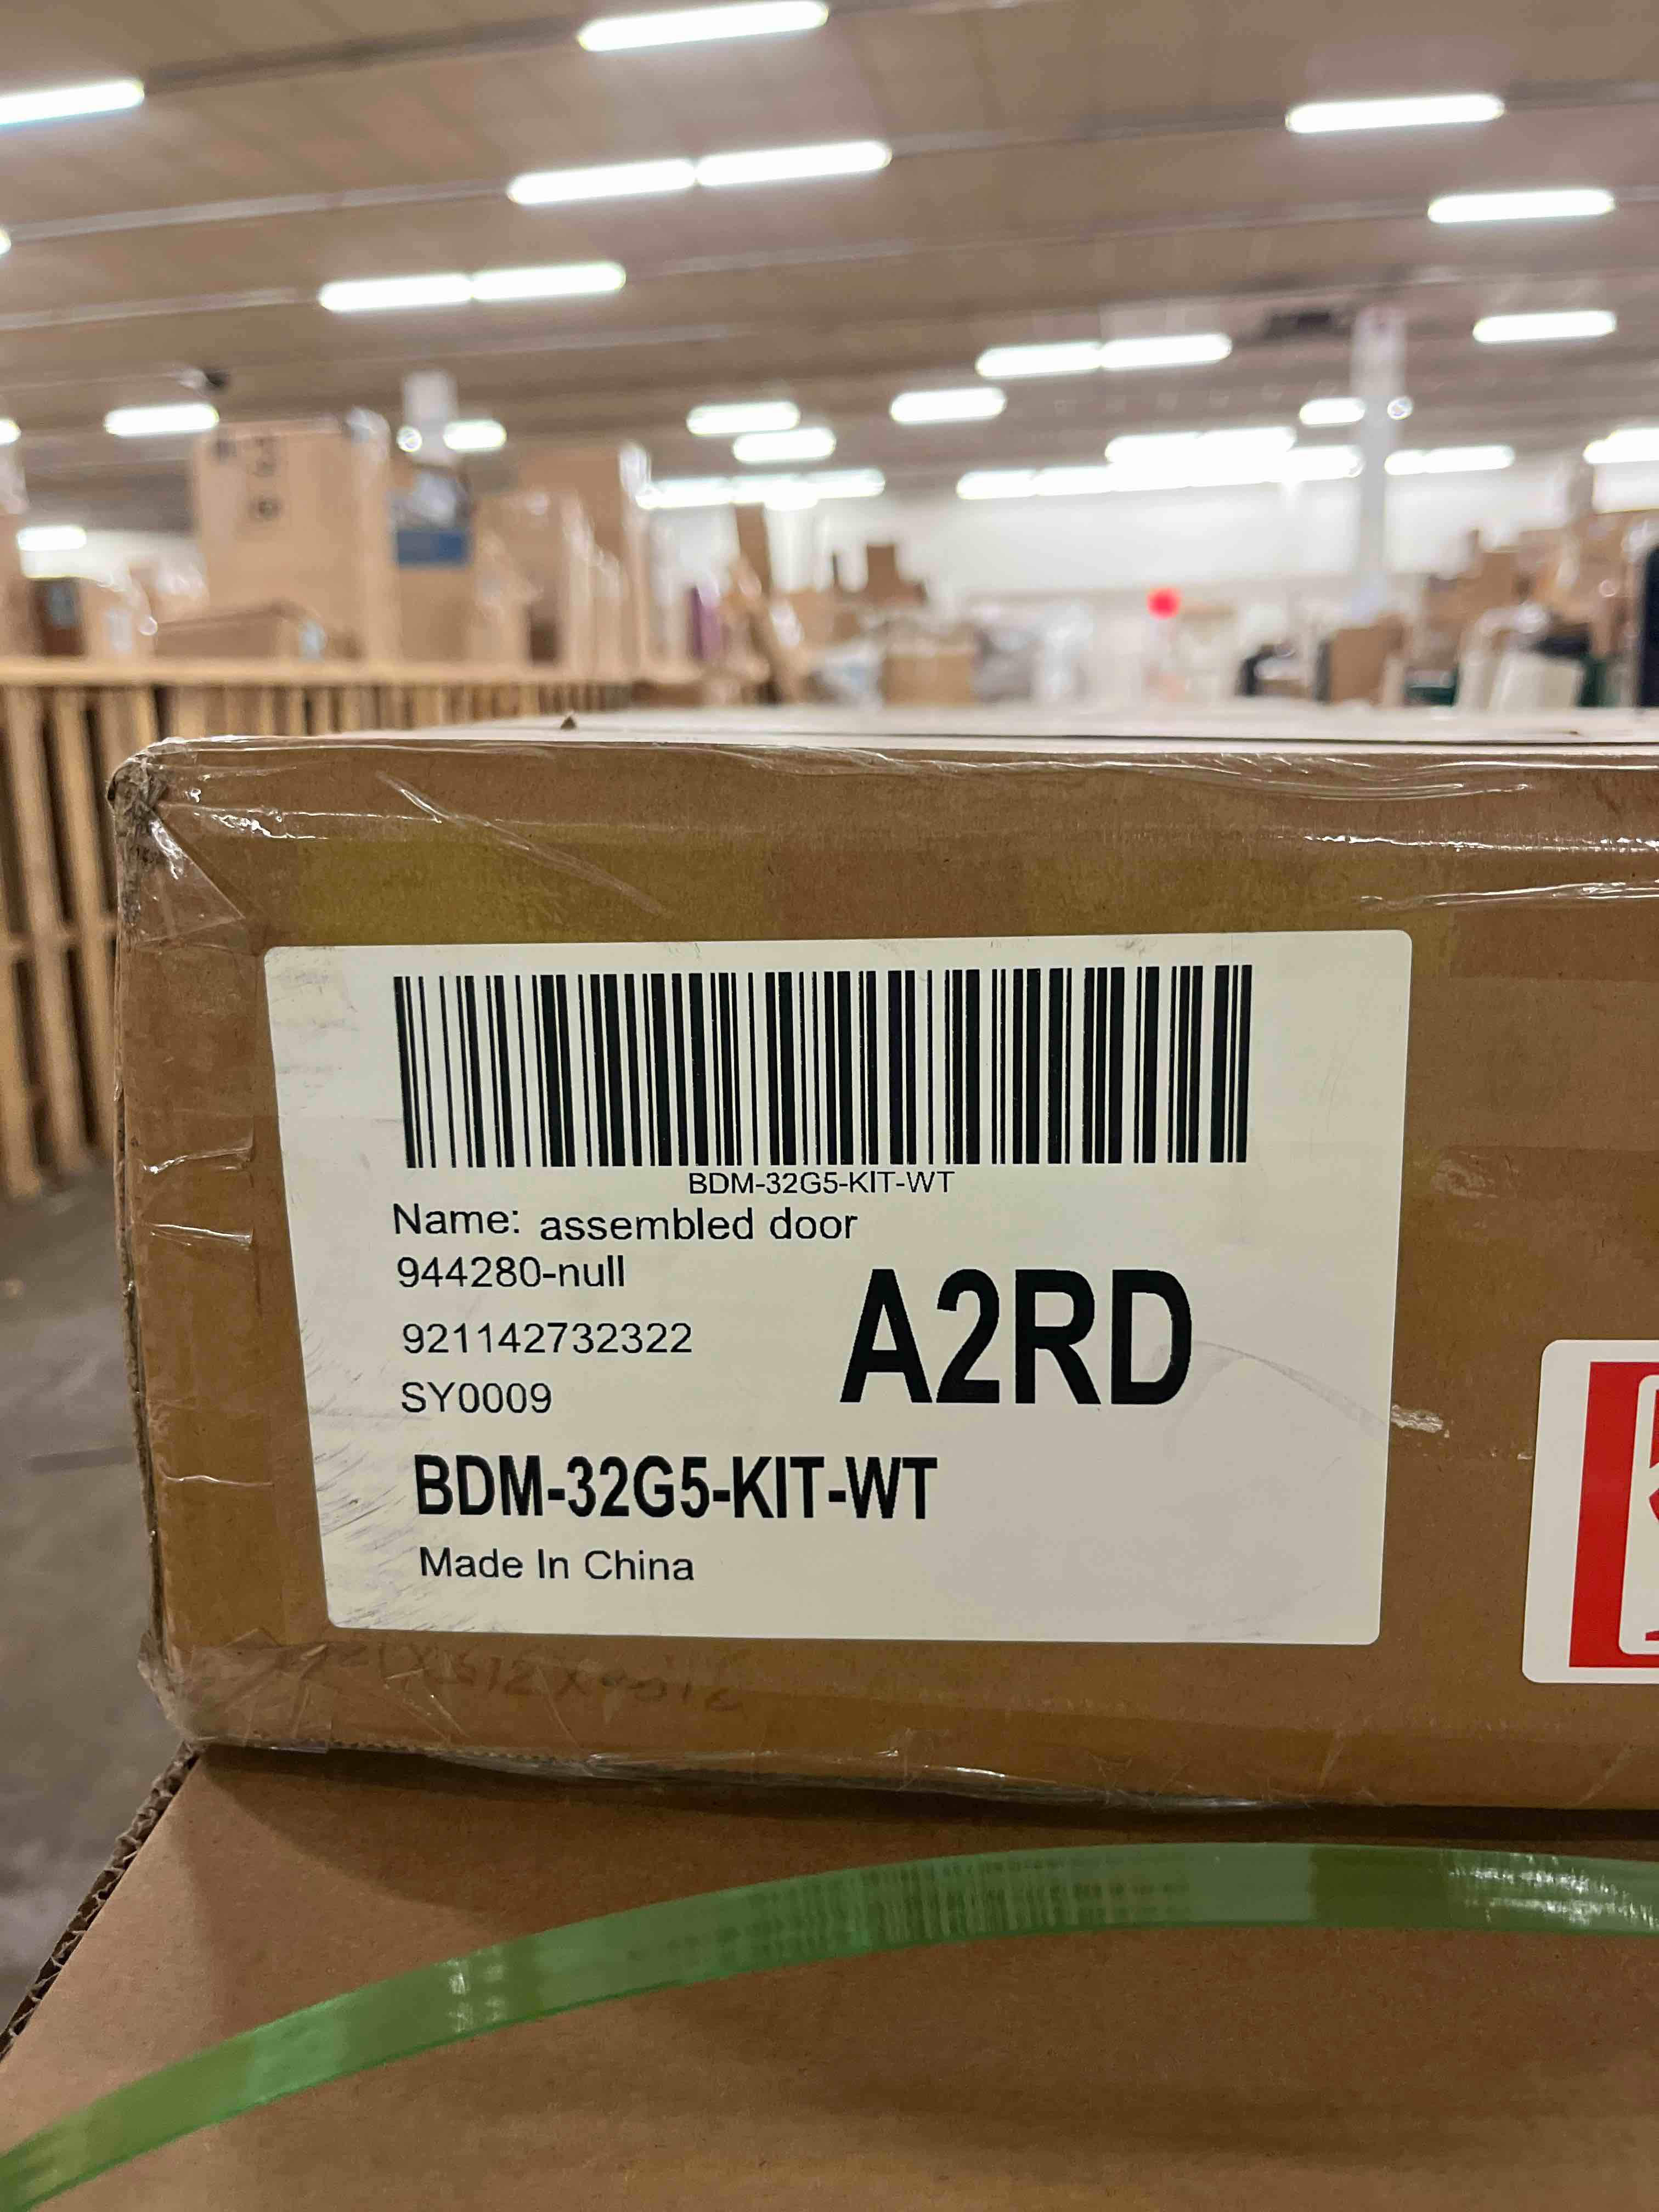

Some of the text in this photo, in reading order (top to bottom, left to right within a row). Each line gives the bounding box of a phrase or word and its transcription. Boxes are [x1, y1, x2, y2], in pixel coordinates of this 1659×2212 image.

[689, 1171, 955, 1194] BDM-32G5-KIT-WT
[393, 1203, 858, 1240] Name: assembled door
[397, 1255, 624, 1288] 944280-null
[403, 1322, 692, 1354] 921142732322
[839, 1268, 1192, 1405] A2RD
[402, 1382, 551, 1414] SY0009
[414, 1454, 938, 1520] BDM-32G5-KIT-WT
[420, 1547, 694, 1581] Made In China
